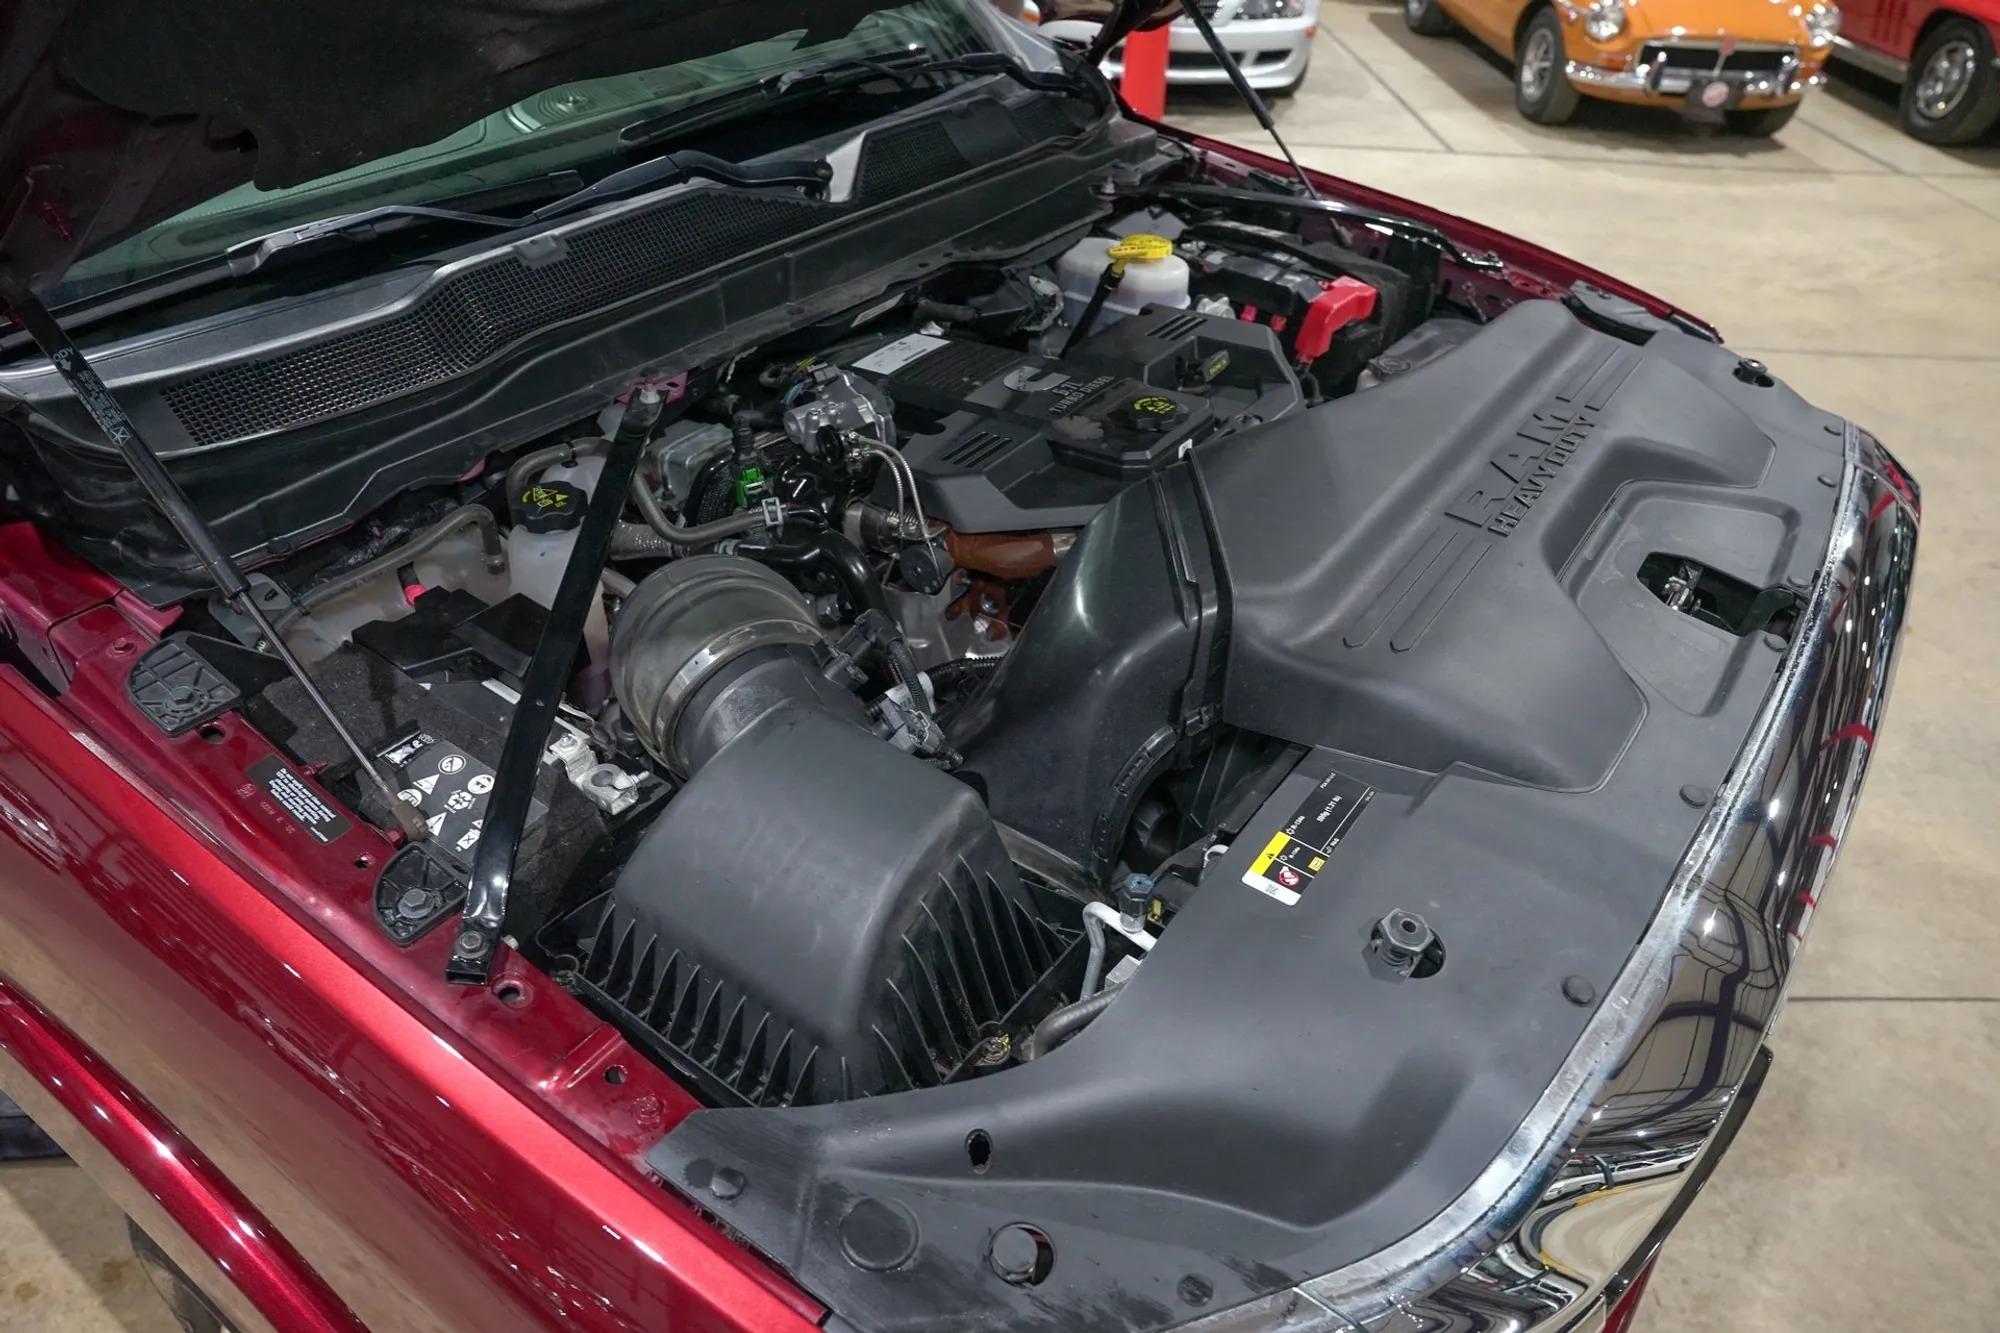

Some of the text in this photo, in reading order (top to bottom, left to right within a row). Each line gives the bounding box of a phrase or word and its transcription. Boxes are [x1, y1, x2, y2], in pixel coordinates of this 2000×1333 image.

[1048, 375, 1115, 413] TURBO DIESEL
[1444, 411, 1578, 529] RAM
[1487, 415, 1596, 539] HEAVY DUTY
